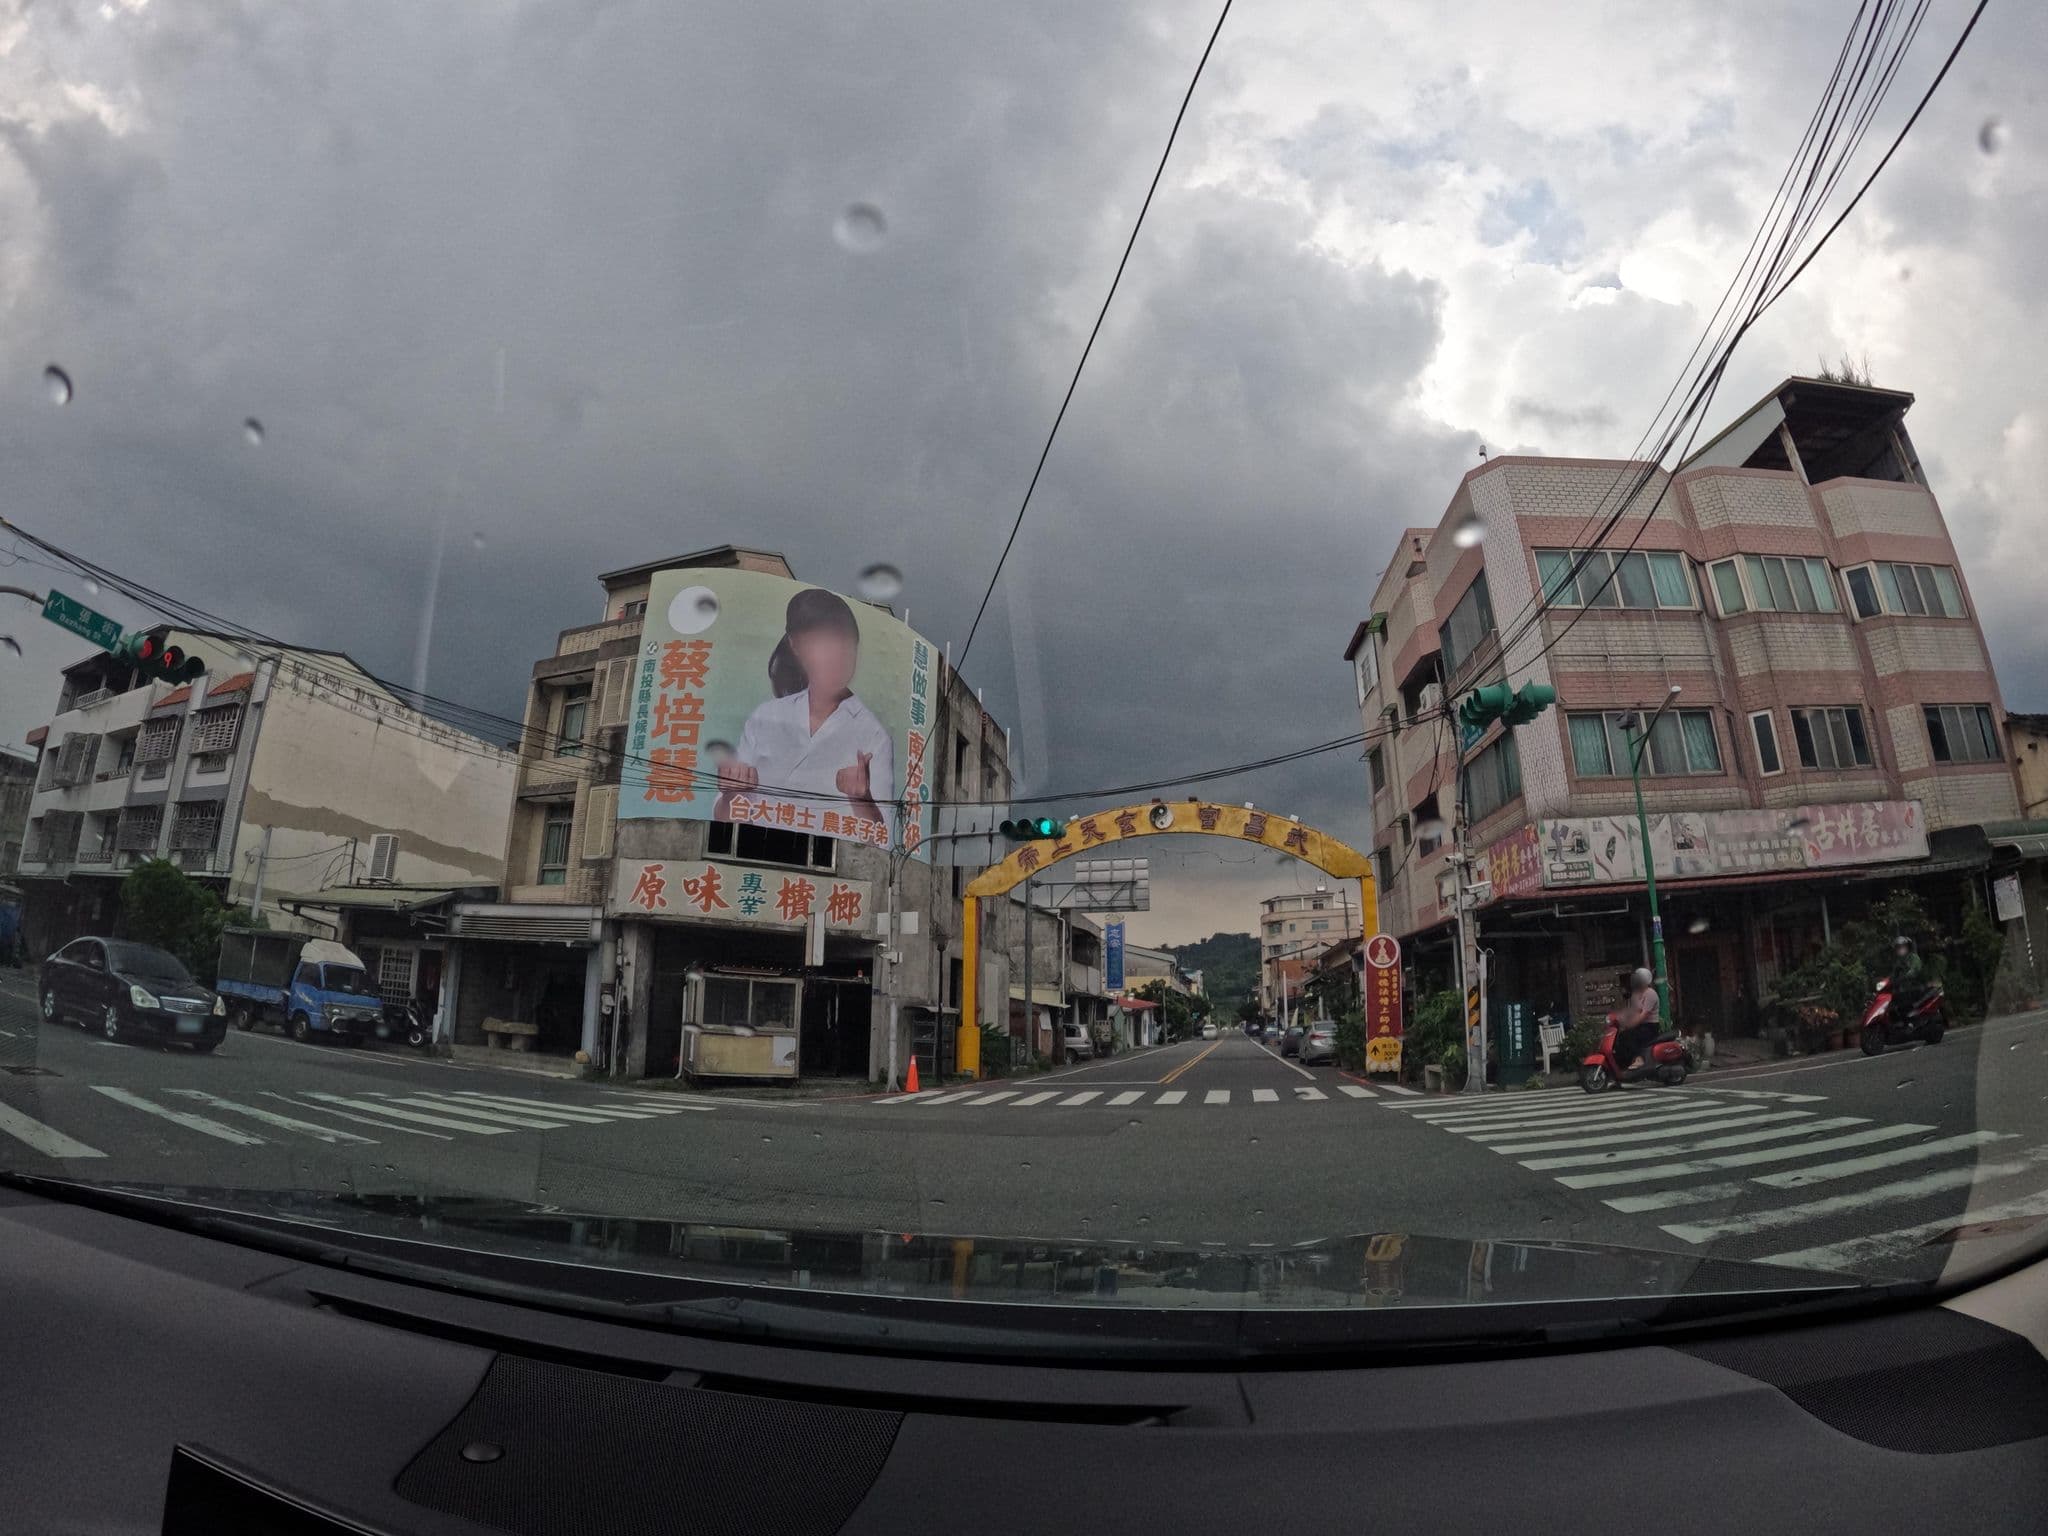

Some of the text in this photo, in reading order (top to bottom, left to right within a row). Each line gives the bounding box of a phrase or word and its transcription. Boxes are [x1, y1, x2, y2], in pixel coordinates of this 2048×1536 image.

[164, 652, 173, 668] 9
[910, 640, 929, 727] 慧做事
[630, 658, 657, 767] 南投縣長候選人
[643, 639, 714, 803] 蔡培慧
[730, 794, 889, 846] 台大博士 農家子弟
[629, 864, 730, 912] 原味
[737, 872, 767, 916] 專業
[775, 877, 862, 925] 檳榔
